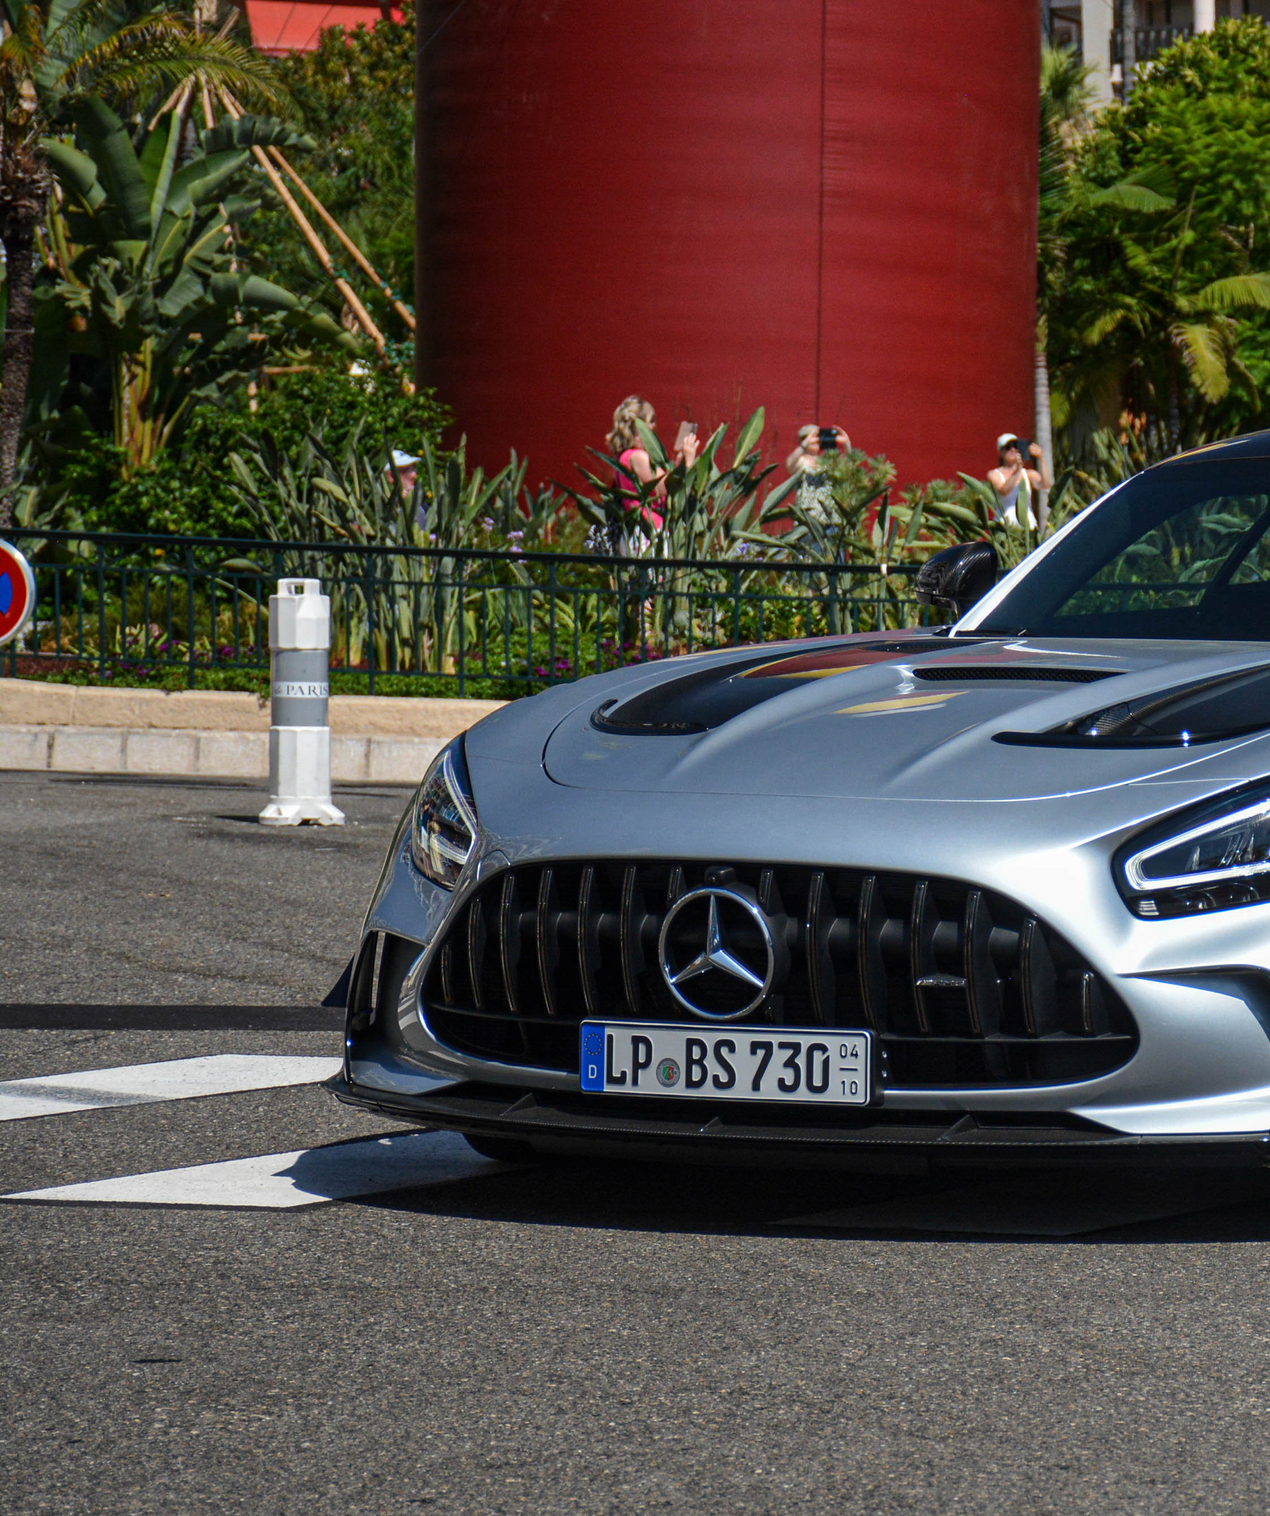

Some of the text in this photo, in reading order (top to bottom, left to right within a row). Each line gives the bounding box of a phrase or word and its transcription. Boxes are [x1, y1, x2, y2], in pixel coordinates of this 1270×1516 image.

[839, 1043, 860, 1060] 04
[588, 1064, 597, 1079] D
[606, 1033, 832, 1094] LP BS 730
[841, 1080, 859, 1096] 10
